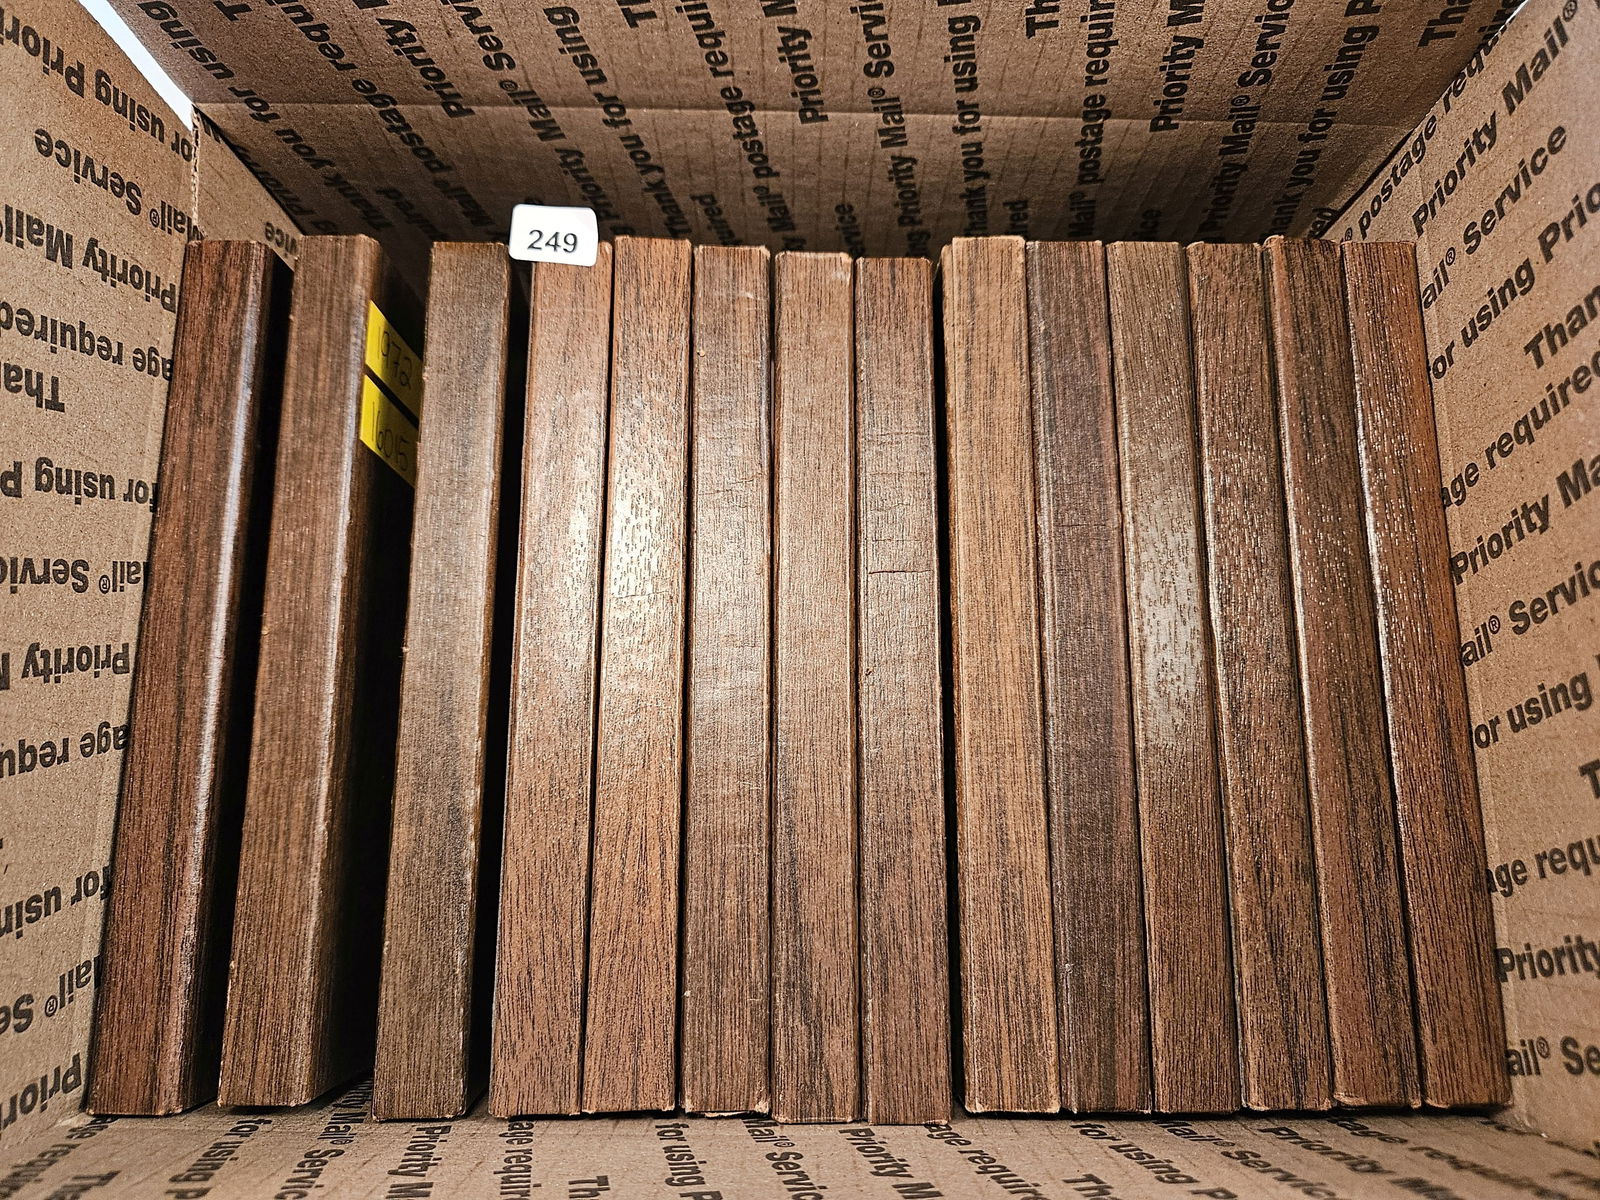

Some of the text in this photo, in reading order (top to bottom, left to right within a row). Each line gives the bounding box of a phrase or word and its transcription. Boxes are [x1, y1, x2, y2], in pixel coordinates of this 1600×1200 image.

[138, 2, 235, 80] using
[376, 17, 475, 118] Priority
[543, 6, 608, 86] using
[943, 15, 981, 94] using
[1320, 26, 1380, 101] using
[95, 70, 165, 143] using
[228, 86, 282, 123] for
[777, 26, 829, 124] Priority
[1150, 35, 1198, 132] Priority
[351, 78, 453, 173] postage
[500, 79, 567, 142] Mail®
[594, 92, 633, 128] for
[720, 87, 780, 179] postage
[866, 87, 908, 148] Mail®
[952, 100, 981, 135] for
[1075, 94, 1112, 185] postage
[1218, 95, 1262, 156] Mail®
[1297, 108, 1338, 143] for
[1411, 110, 1497, 237] Priority
[1501, 0, 1578, 117] Mail®
[34, 129, 142, 216] Service
[274, 128, 335, 170] you
[620, 134, 665, 176] you
[963, 142, 991, 183] you
[1286, 150, 1322, 189] you
[1357, 114, 1437, 240] postage
[1462, 124, 1567, 256] Service
[527, 229, 578, 254] 249
[82, 237, 177, 314] Priority
[1460, 257, 1537, 348] using
[34, 457, 116, 505] using
[1450, 493, 1550, 587] Priority
[21, 642, 131, 684] Priority
[1506, 671, 1593, 734] using
[168, 1118, 273, 1183] for using
[317, 1111, 368, 1147] Mail®
[386, 1125, 452, 1177] Priority
[654, 1121, 690, 1142] for
[838, 1127, 915, 1179] Priority
[1070, 1121, 1200, 1184] for using
[664, 1144, 708, 1187] using
